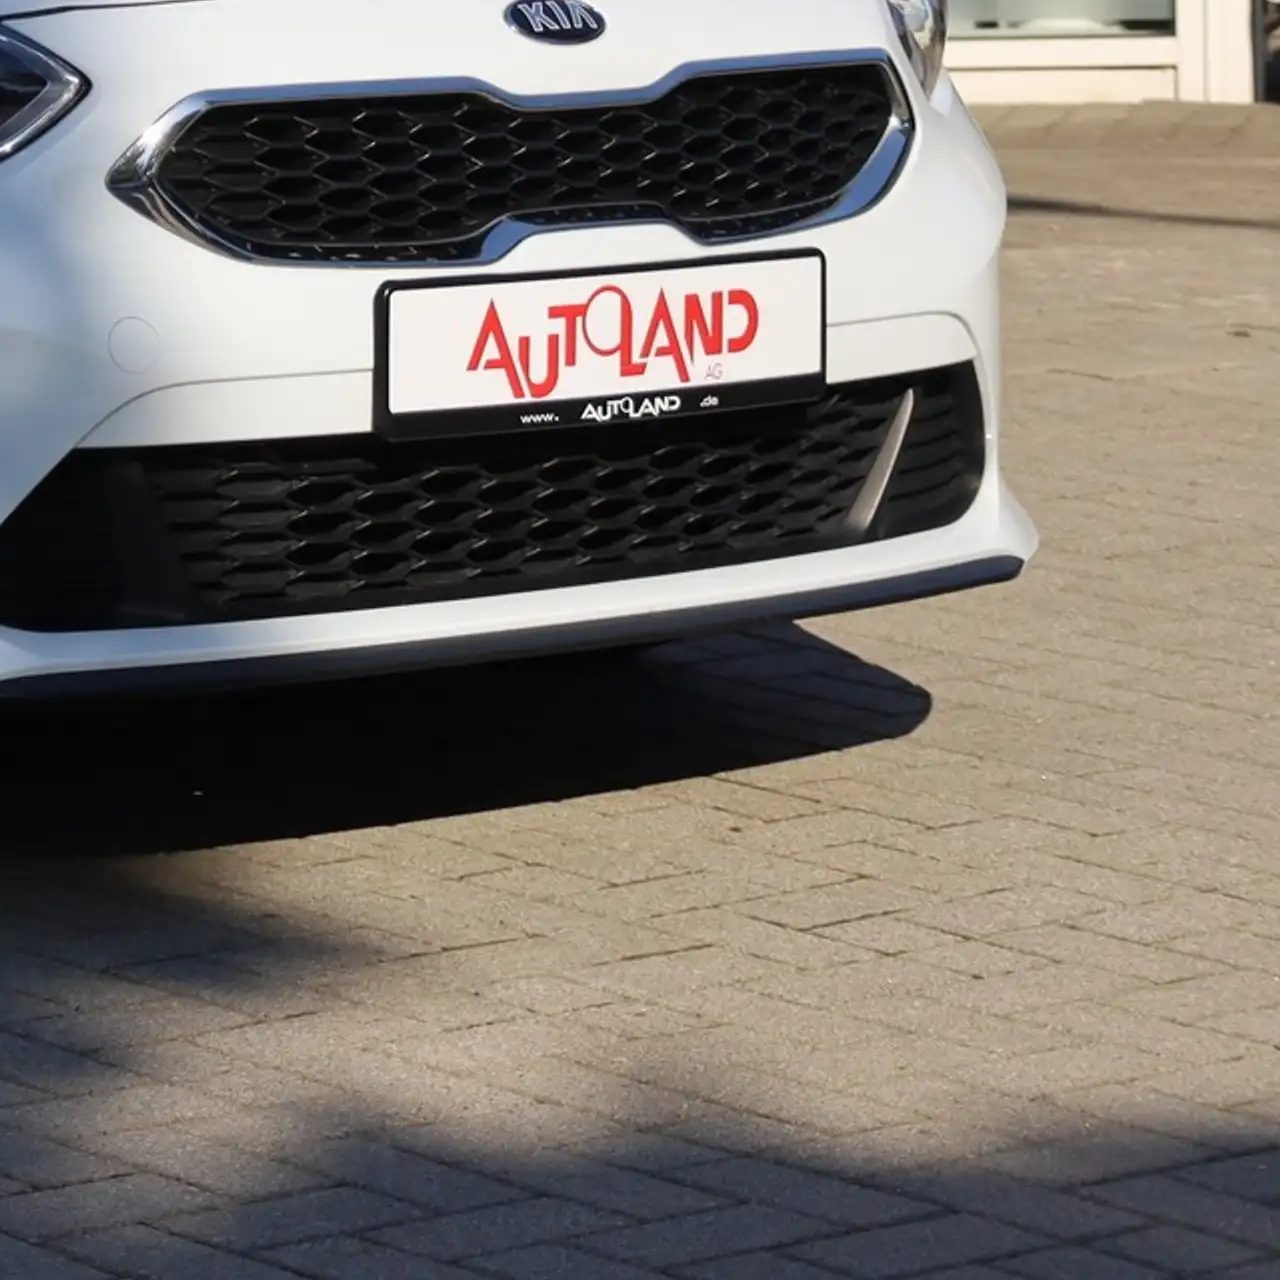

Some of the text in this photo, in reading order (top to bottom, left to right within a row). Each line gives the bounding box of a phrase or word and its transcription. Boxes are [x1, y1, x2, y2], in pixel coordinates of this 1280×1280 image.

[517, 0, 598, 32] KIA
[467, 285, 759, 399] AUTOLAND
[520, 394, 719, 424] www. AUTOLAND .de
